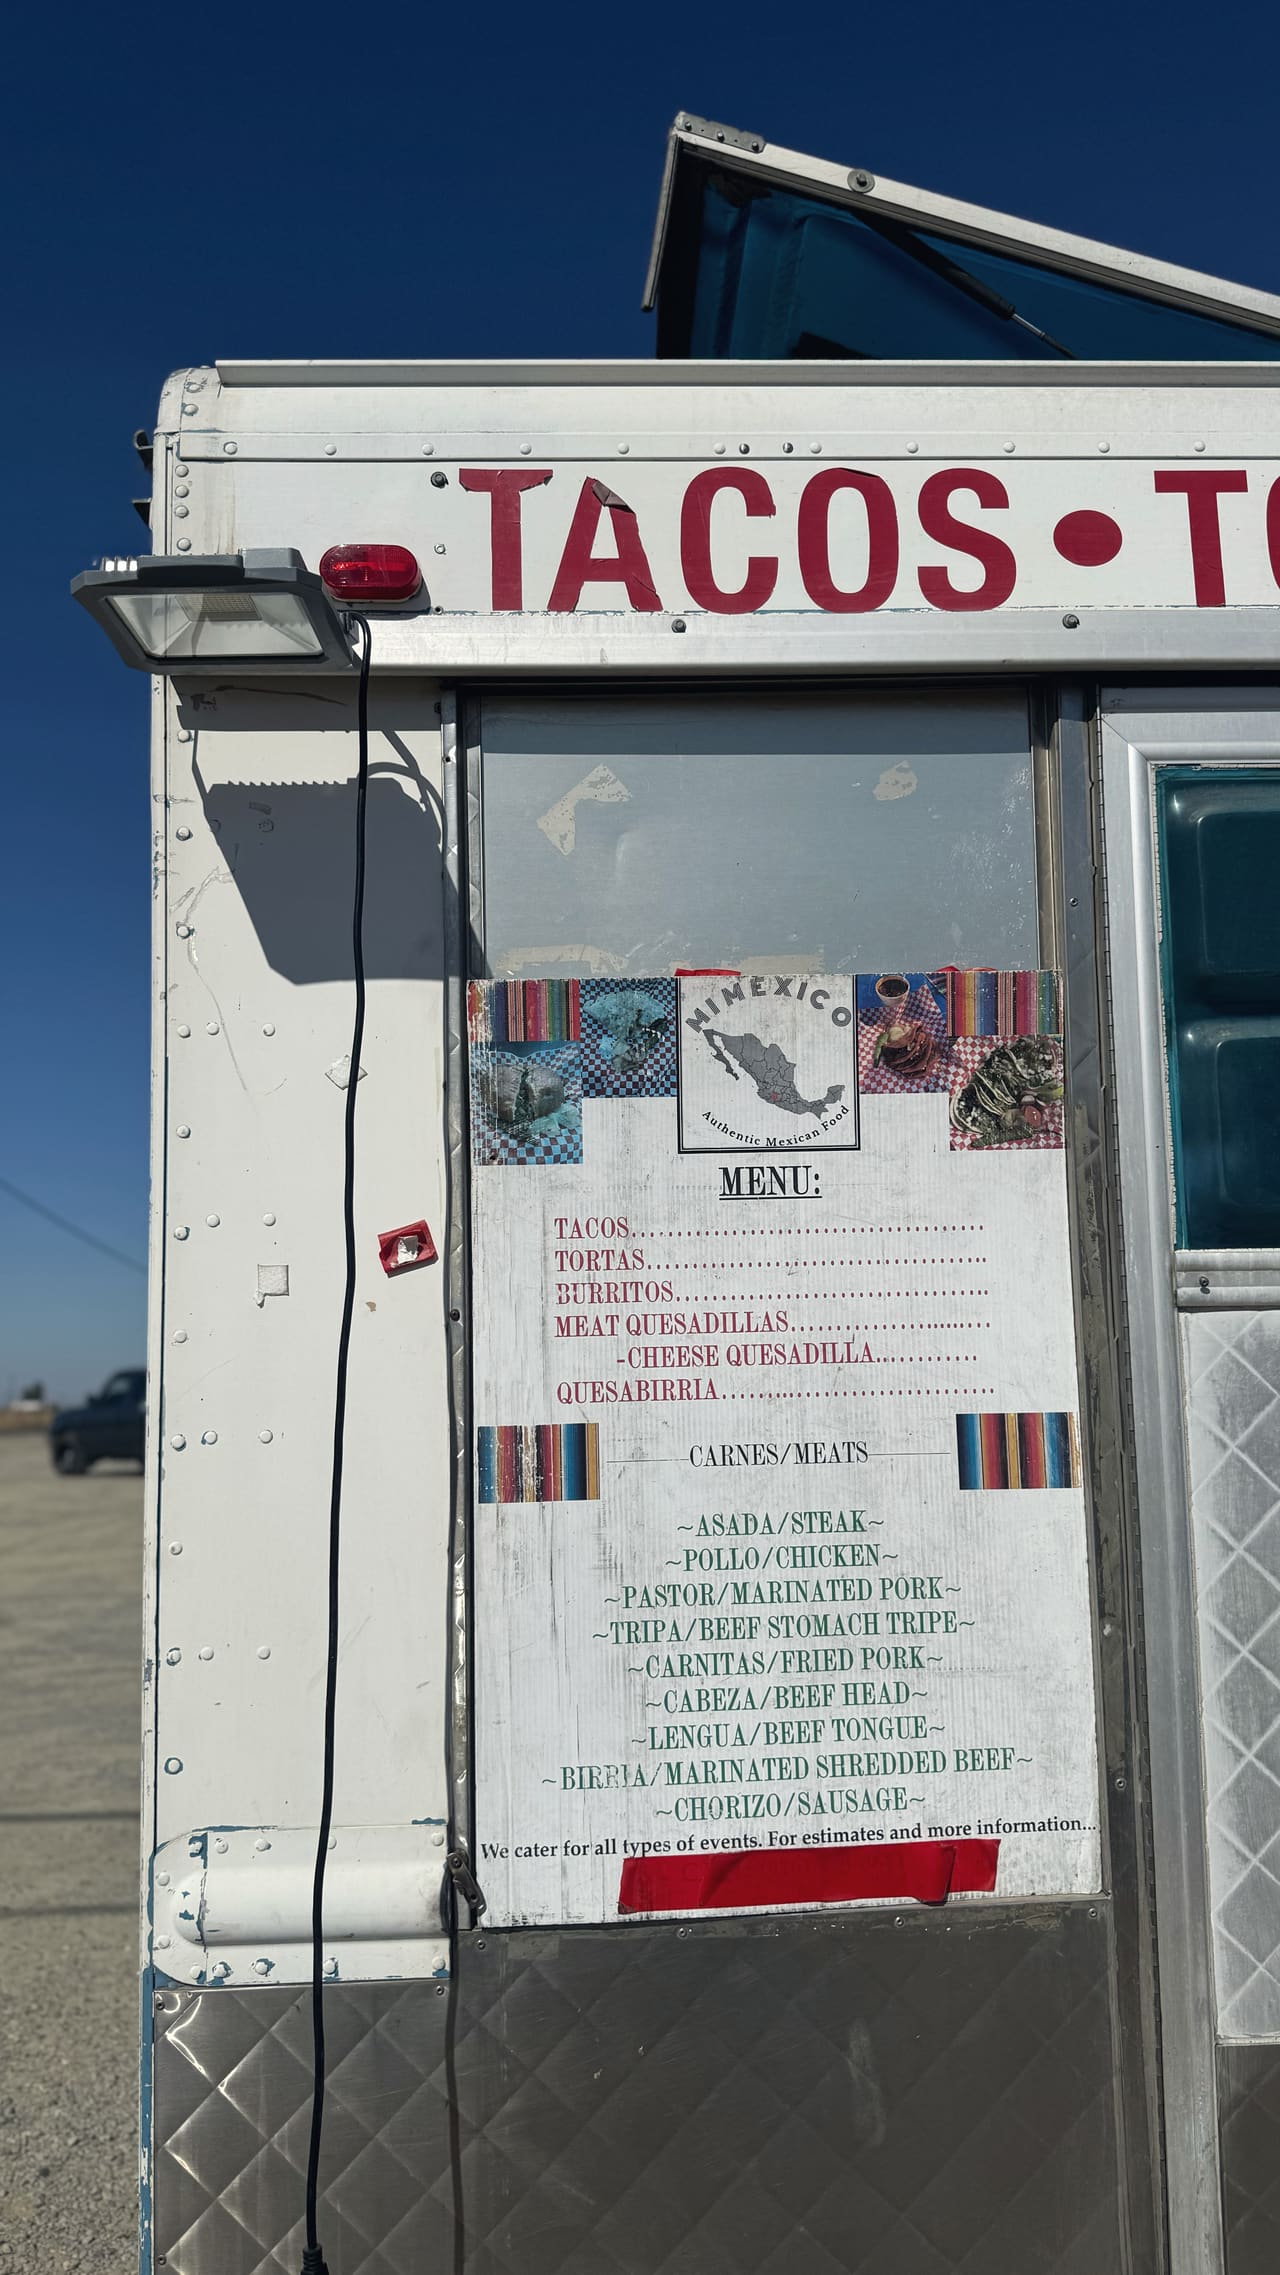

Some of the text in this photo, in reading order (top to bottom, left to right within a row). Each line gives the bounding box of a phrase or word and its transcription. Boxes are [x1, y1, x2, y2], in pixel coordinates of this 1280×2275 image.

[459, 466, 1280, 614] TACOS T
[702, 1105, 849, 1147] Authentic Mexican Food
[719, 1165, 822, 1200] MENU:
[554, 1314, 619, 1338] MEAT
[616, 1345, 719, 1369] -CHEESE
[689, 1441, 869, 1468] CARNES/MEATS
[767, 1612, 881, 1640] STOMACH
[815, 1750, 948, 1779] SHREDDED
[481, 1815, 1097, 1859] We cater for all types of events. For estimates and more information...
